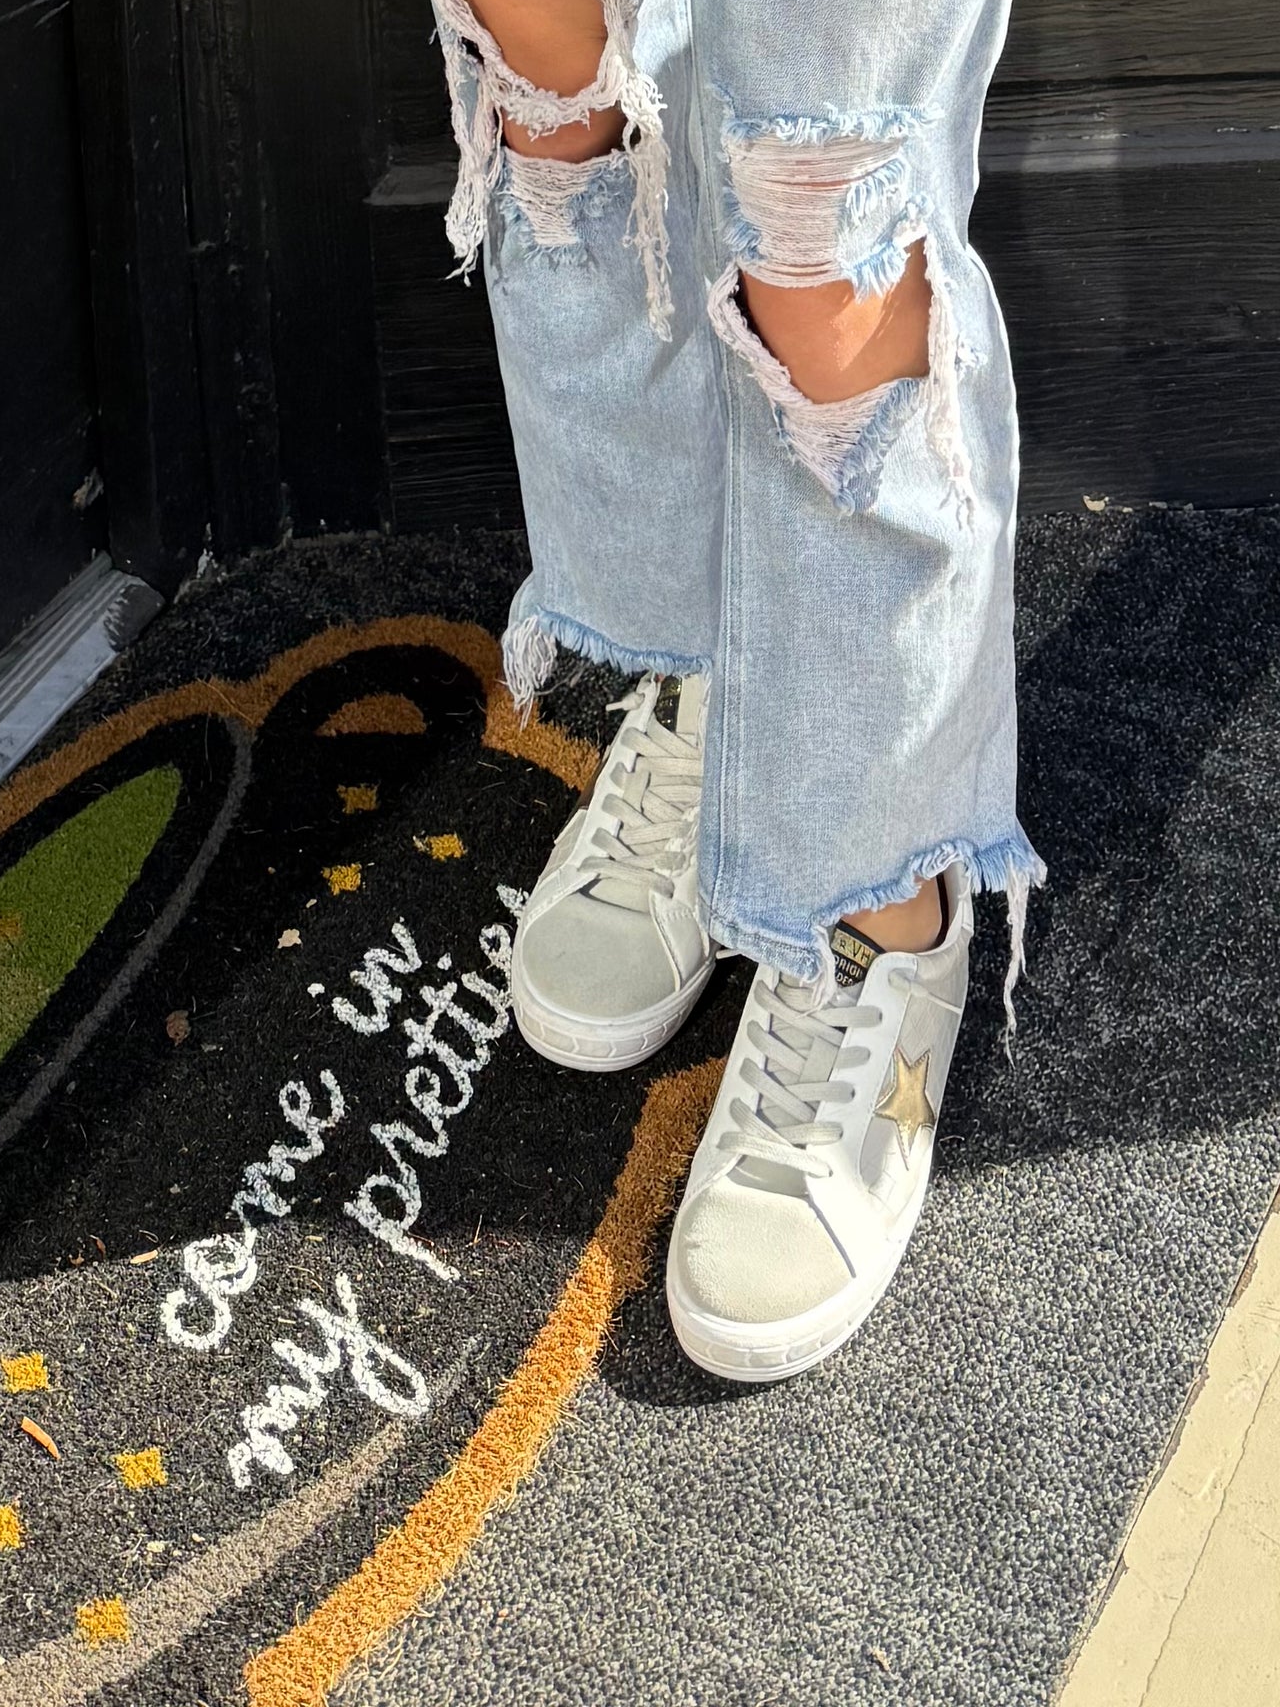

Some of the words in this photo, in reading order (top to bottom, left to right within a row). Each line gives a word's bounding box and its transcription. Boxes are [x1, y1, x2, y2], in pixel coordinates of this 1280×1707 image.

[161, 1069, 345, 1351] come
[307, 918, 421, 1035] in
[226, 1271, 430, 1488] my
